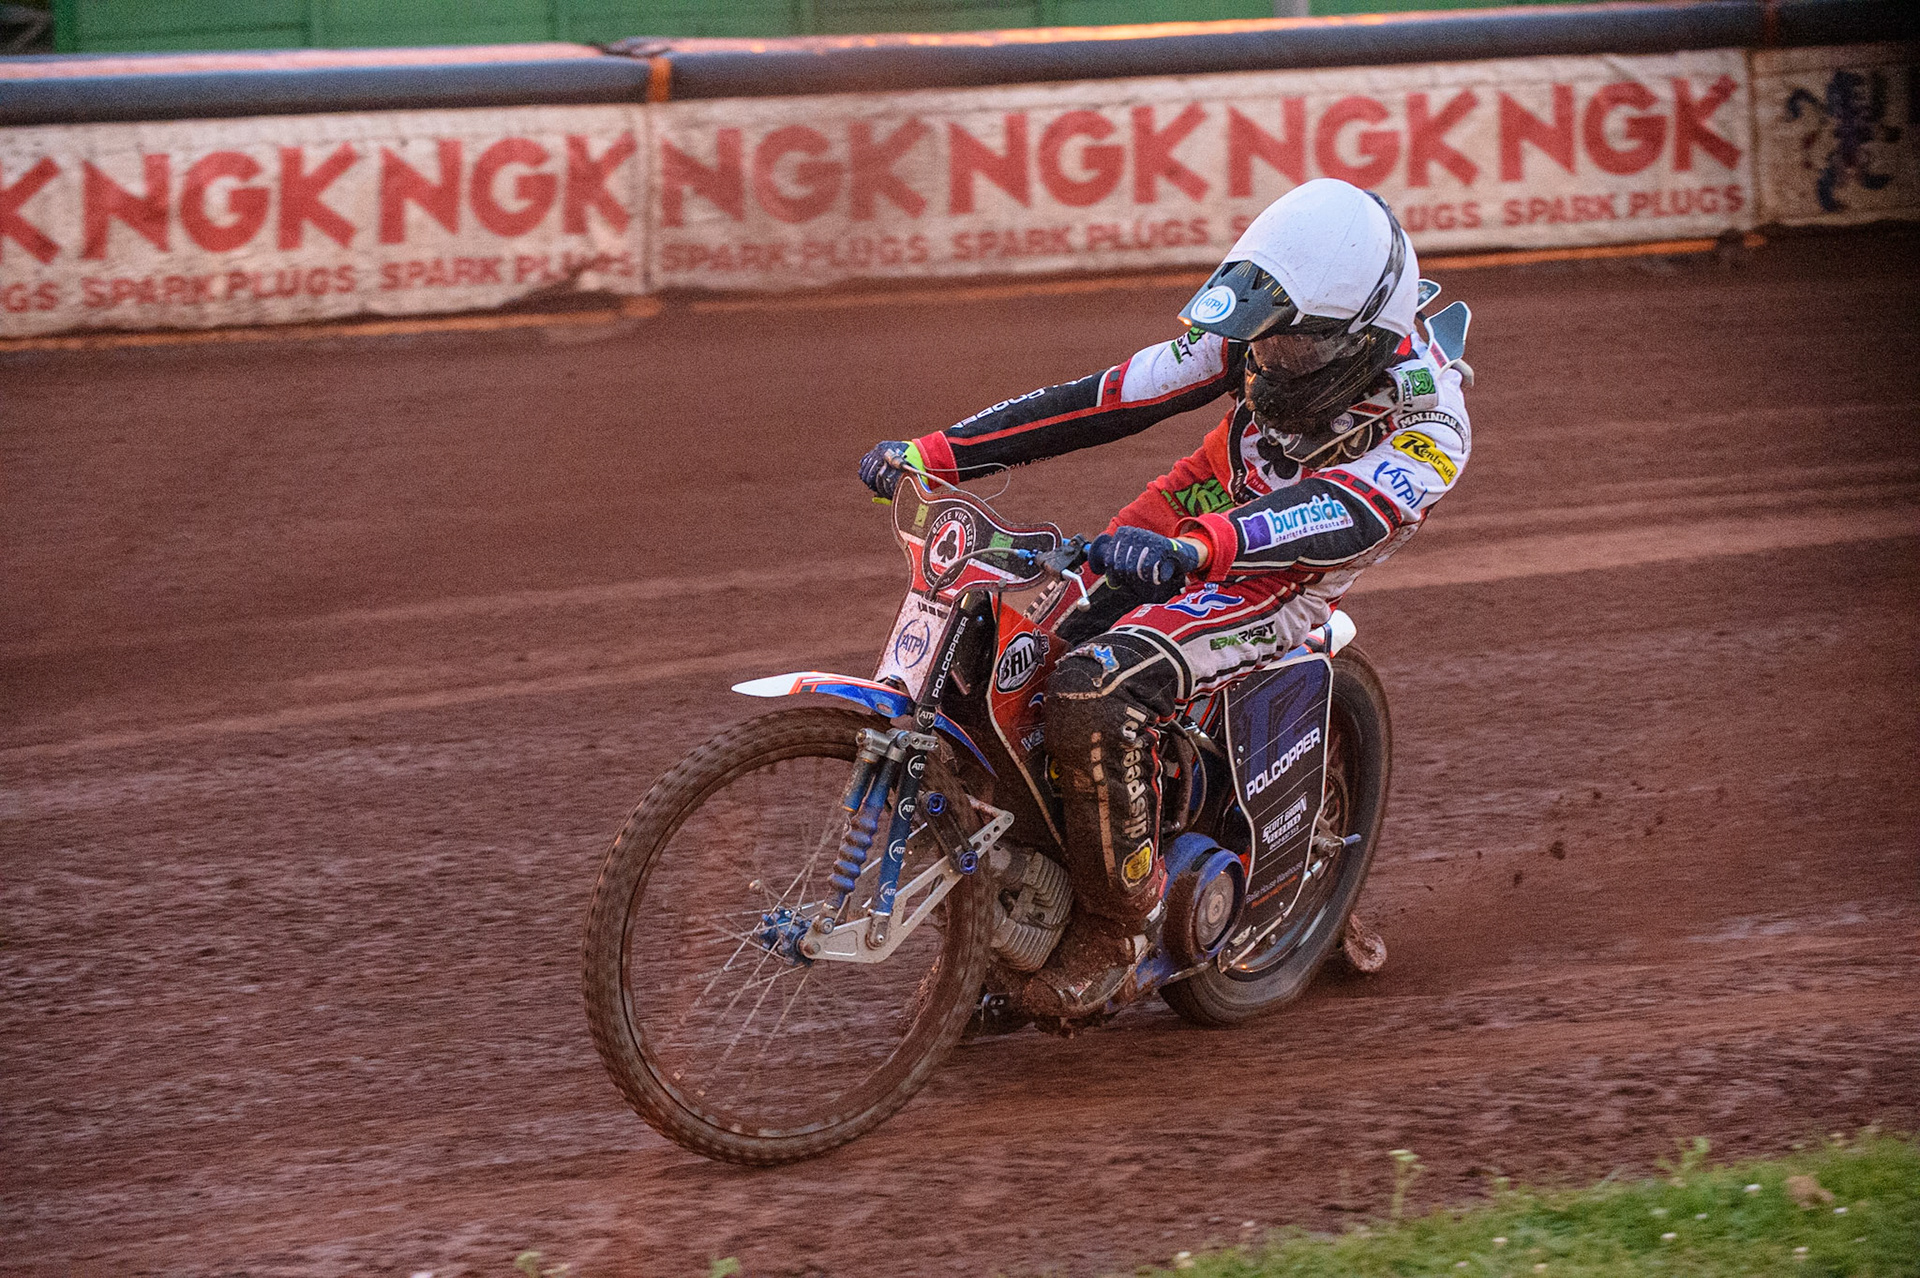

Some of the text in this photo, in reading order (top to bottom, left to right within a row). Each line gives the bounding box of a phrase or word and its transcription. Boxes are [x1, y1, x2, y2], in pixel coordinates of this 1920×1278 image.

[662, 75, 1743, 228] NGK NGK NGK NGK
[82, 142, 359, 260] NGK
[379, 132, 638, 245] NGK
[1502, 193, 1618, 226] SPARK
[1628, 184, 1744, 218] PLUGS
[951, 226, 1072, 260] SPARK
[1085, 217, 1210, 251] PLUGS
[226, 265, 356, 298] PLUGS
[379, 257, 502, 291] SPARK
[1383, 467, 1417, 506] ATPI
[931, 510, 952, 534] BELLE
[954, 510, 968, 524] VUE
[1268, 497, 1347, 534] burnside
[900, 633, 926, 656] ATPI
[931, 616, 969, 699] POLCOPPER
[1246, 727, 1321, 801] POLCOPPER
